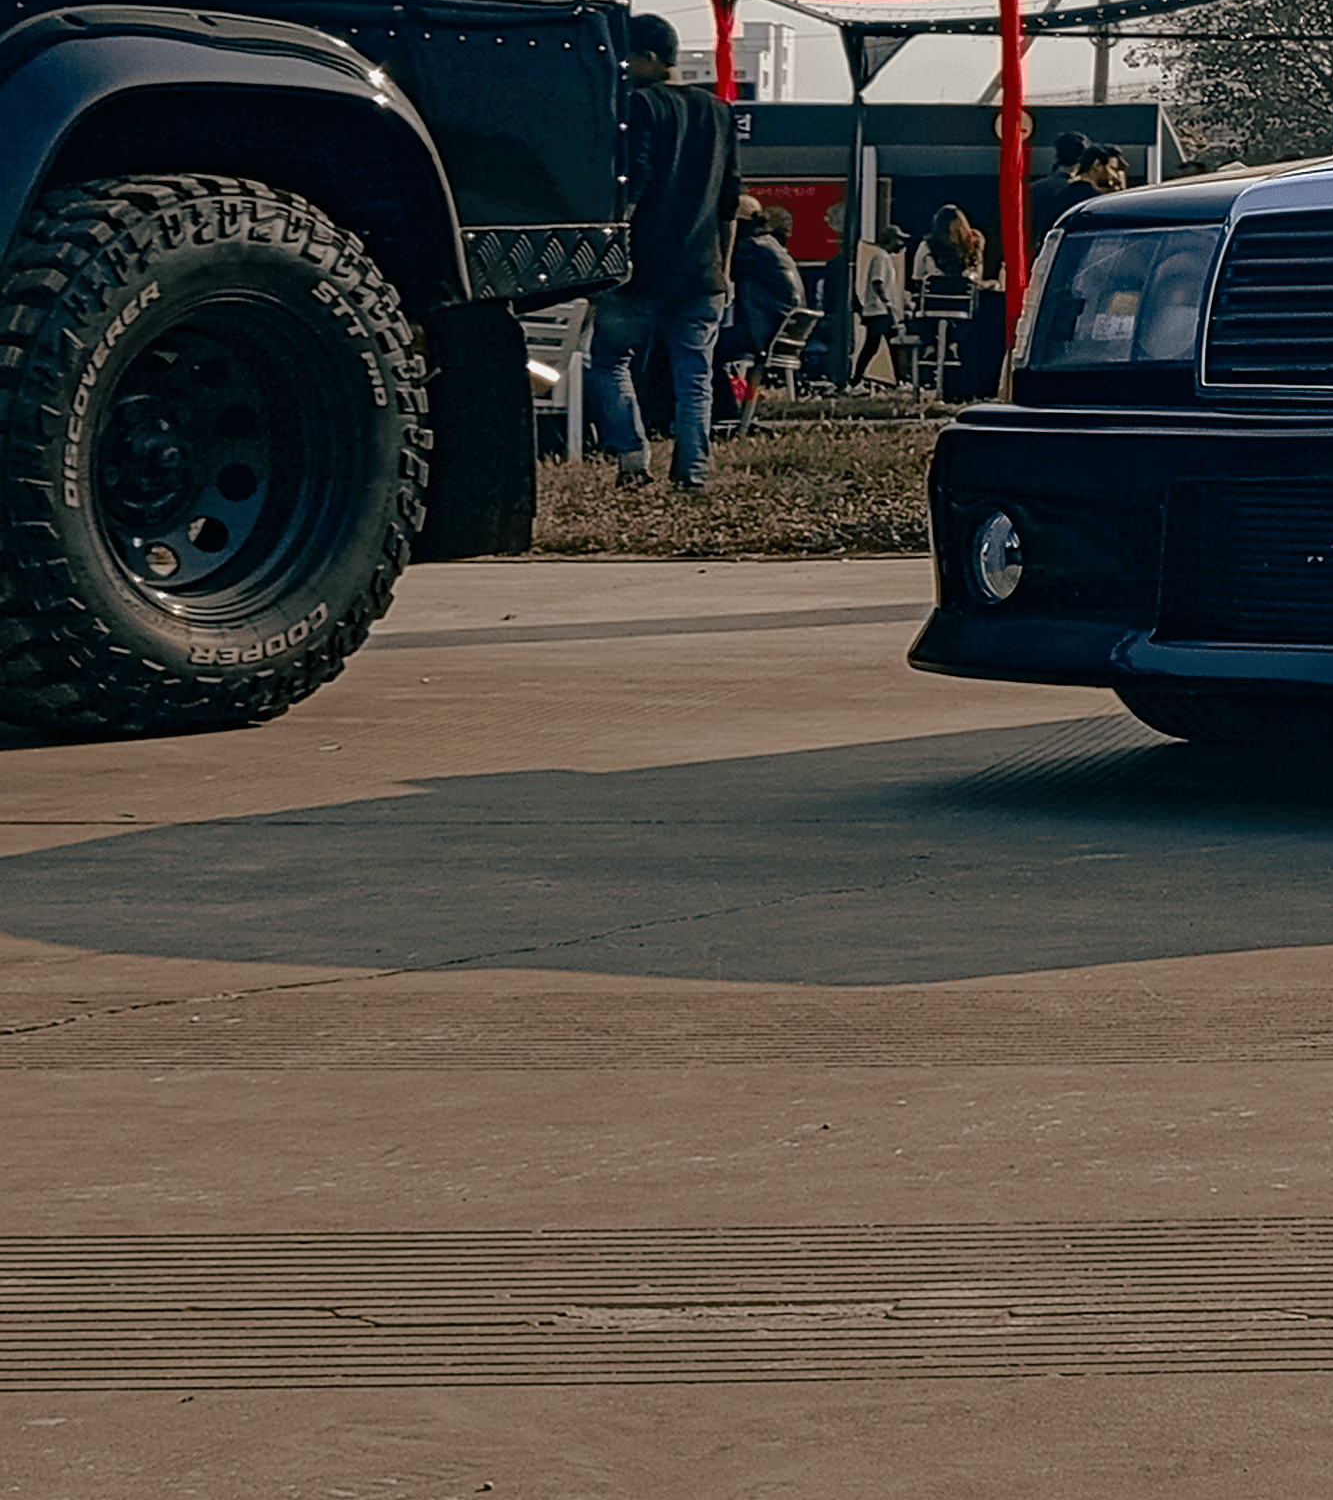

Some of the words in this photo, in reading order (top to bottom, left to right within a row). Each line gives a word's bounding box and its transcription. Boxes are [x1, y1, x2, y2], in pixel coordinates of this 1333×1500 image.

[63, 281, 161, 509] DISCOVERER
[311, 281, 369, 338] STT
[361, 351, 388, 407] PRO
[189, 602, 329, 665] COOPER
